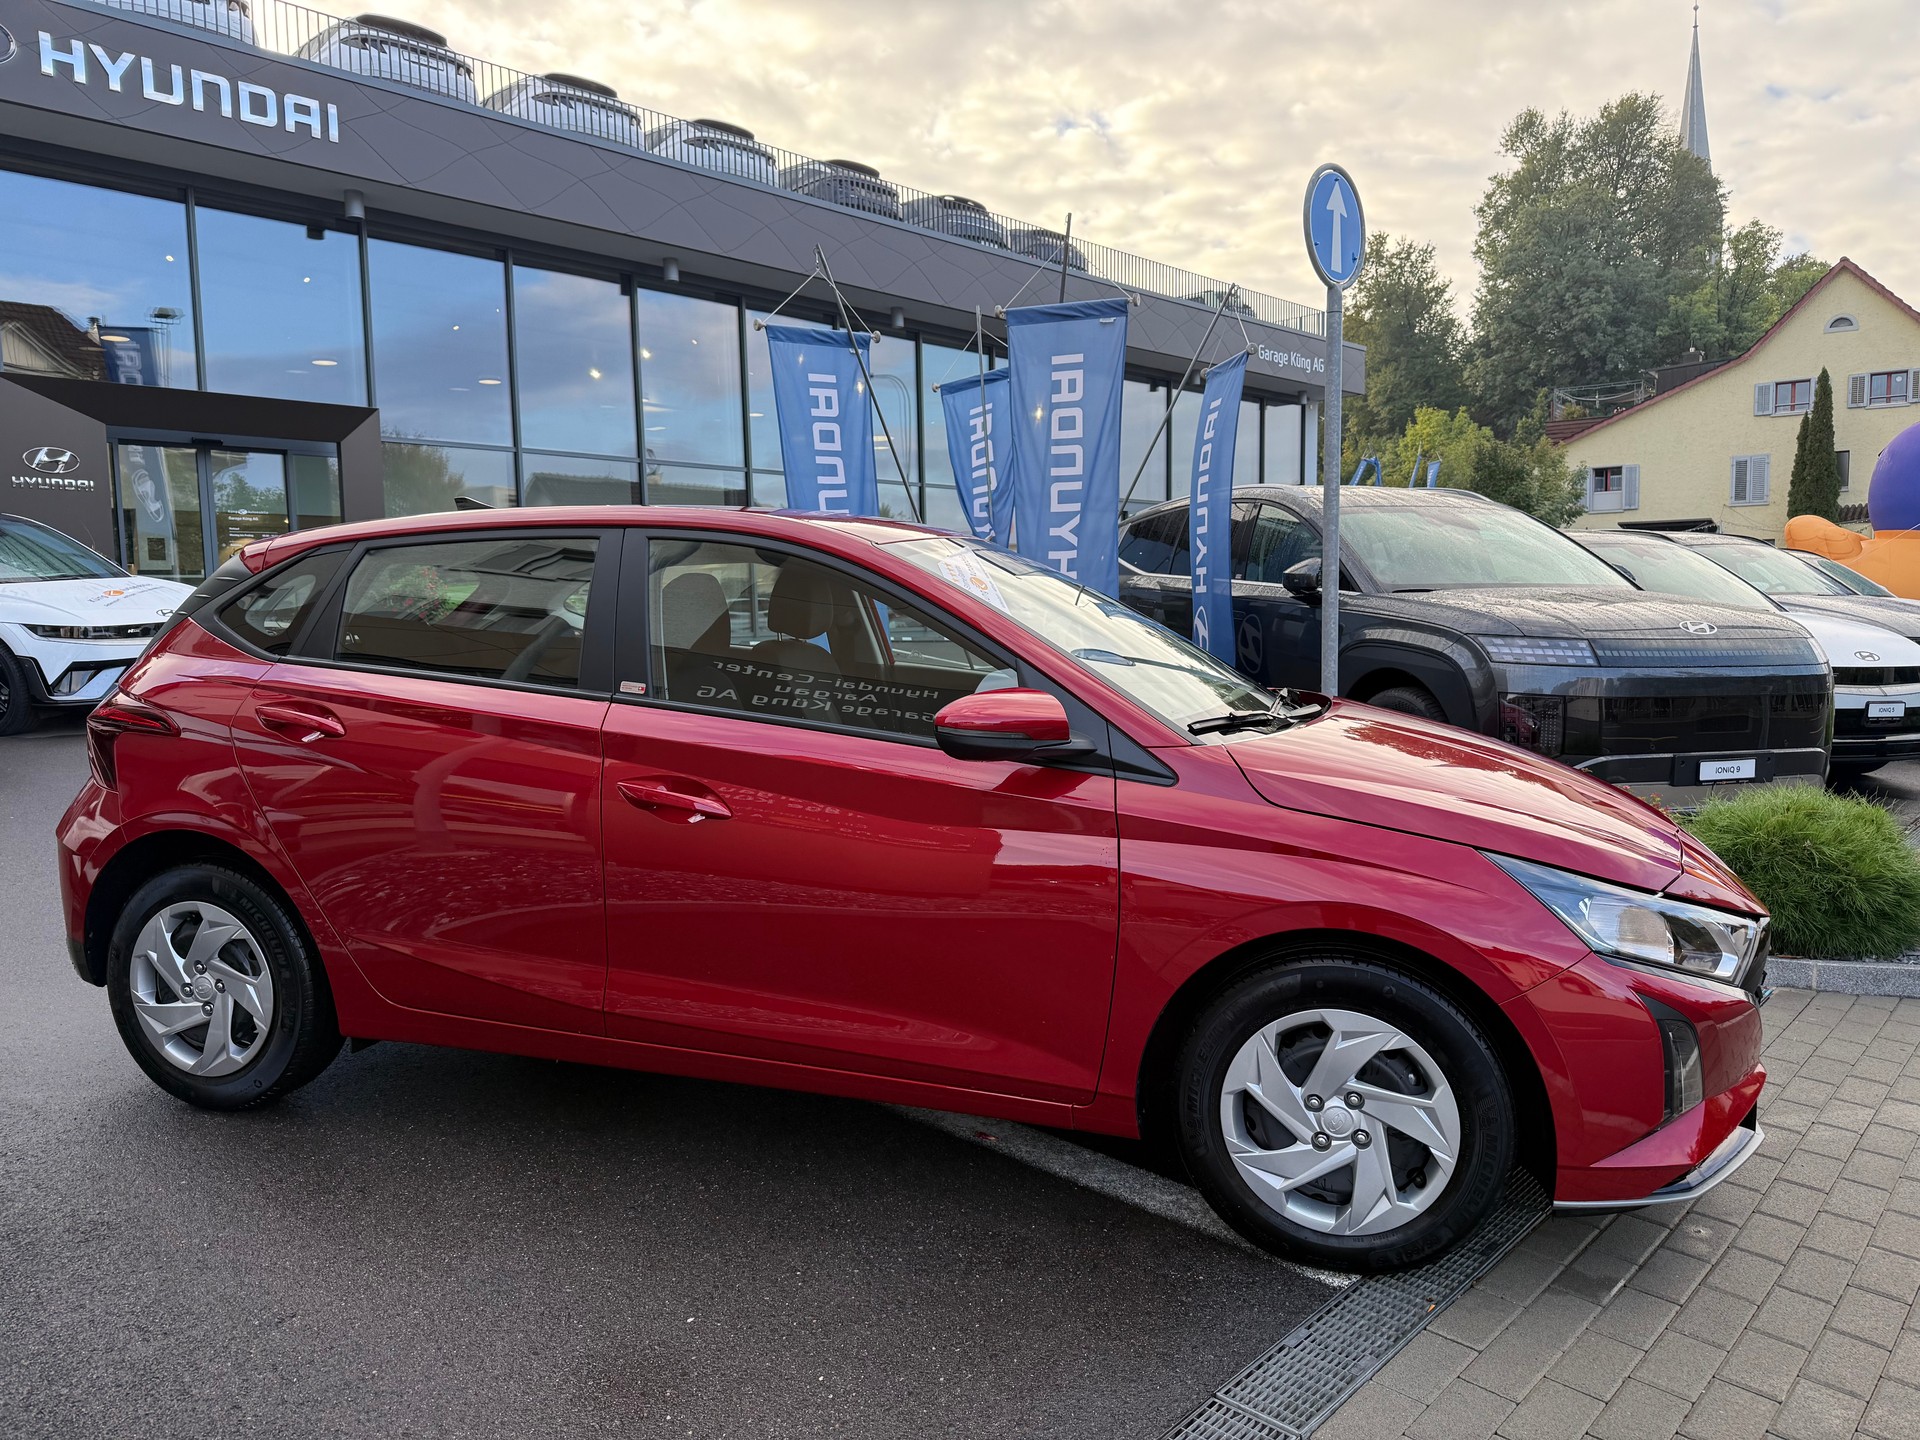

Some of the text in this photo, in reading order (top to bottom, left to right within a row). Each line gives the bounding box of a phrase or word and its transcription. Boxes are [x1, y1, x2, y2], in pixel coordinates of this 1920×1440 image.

[38, 30, 339, 143] HYUNDAI
[1258, 344, 1325, 373] Garage Küng AG
[11, 475, 95, 491] HYUNDAI
[1195, 397, 1222, 593] HYUNDAI
[1715, 766, 1735, 774] IONIQ
[240, 898, 287, 966] MICHELIN
